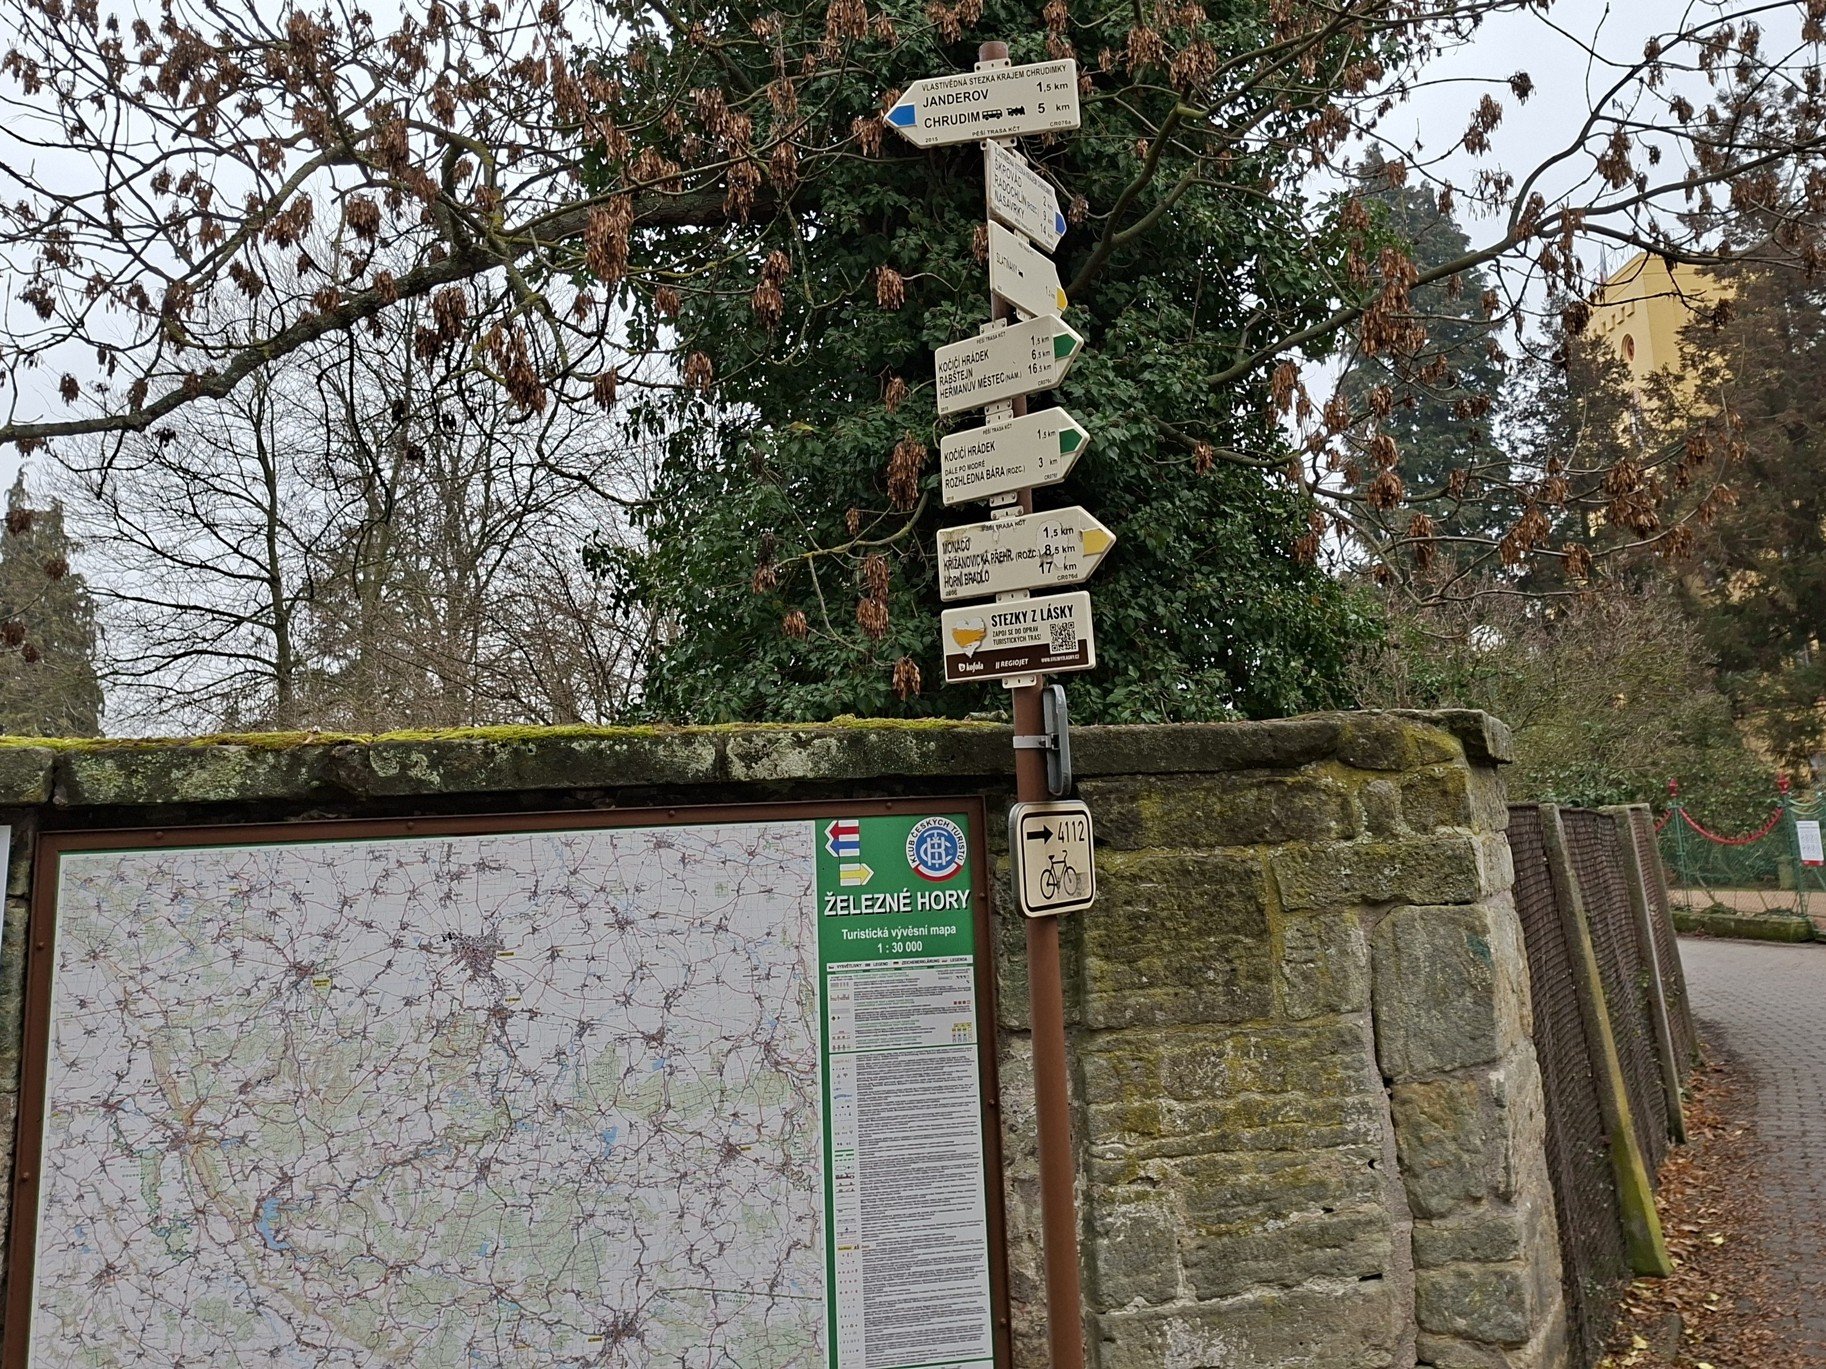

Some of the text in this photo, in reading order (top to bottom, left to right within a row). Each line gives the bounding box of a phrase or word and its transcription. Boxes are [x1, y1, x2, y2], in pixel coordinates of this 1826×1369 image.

[970, 74, 995, 85] STEZKA
[997, 70, 1024, 81] KRAJEM
[1026, 64, 1067, 77] CHRUDIMKY
[922, 89, 989, 108] JANDEROV
[1054, 82, 1068, 90] km
[924, 103, 1070, 128] CHRUDIM 5 km
[1043, 196, 1046, 206] 2
[938, 356, 960, 373] KOČIČÍ
[962, 350, 989, 366] HRÁDEK
[939, 368, 973, 386] RABŠTEJN
[944, 445, 966, 463] KOČIČÍ
[968, 440, 996, 457] HRÁDEK
[945, 467, 958, 476] DÁLE
[946, 472, 986, 488] ROZHLEDNA
[986, 466, 1005, 480] BÁRA
[1038, 458, 1044, 468] 3
[1060, 526, 1074, 536] km
[1062, 546, 1076, 554] km
[1039, 562, 1052, 574] 17
[1064, 562, 1077, 571] km
[991, 604, 1074, 628] STEZKY Z LÁSKY
[966, 661, 984, 673] kofola
[1000, 658, 1028, 668] REGIOJET
[1058, 820, 1084, 843] 4112
[908, 840, 917, 864] KLUB
[824, 888, 970, 916] ŽELEZNÉ HORY
[842, 925, 956, 940] Turistická vývěsní mapa
[878, 943, 882, 954] 1
[892, 942, 904, 952] 30
[906, 941, 922, 952] 000
